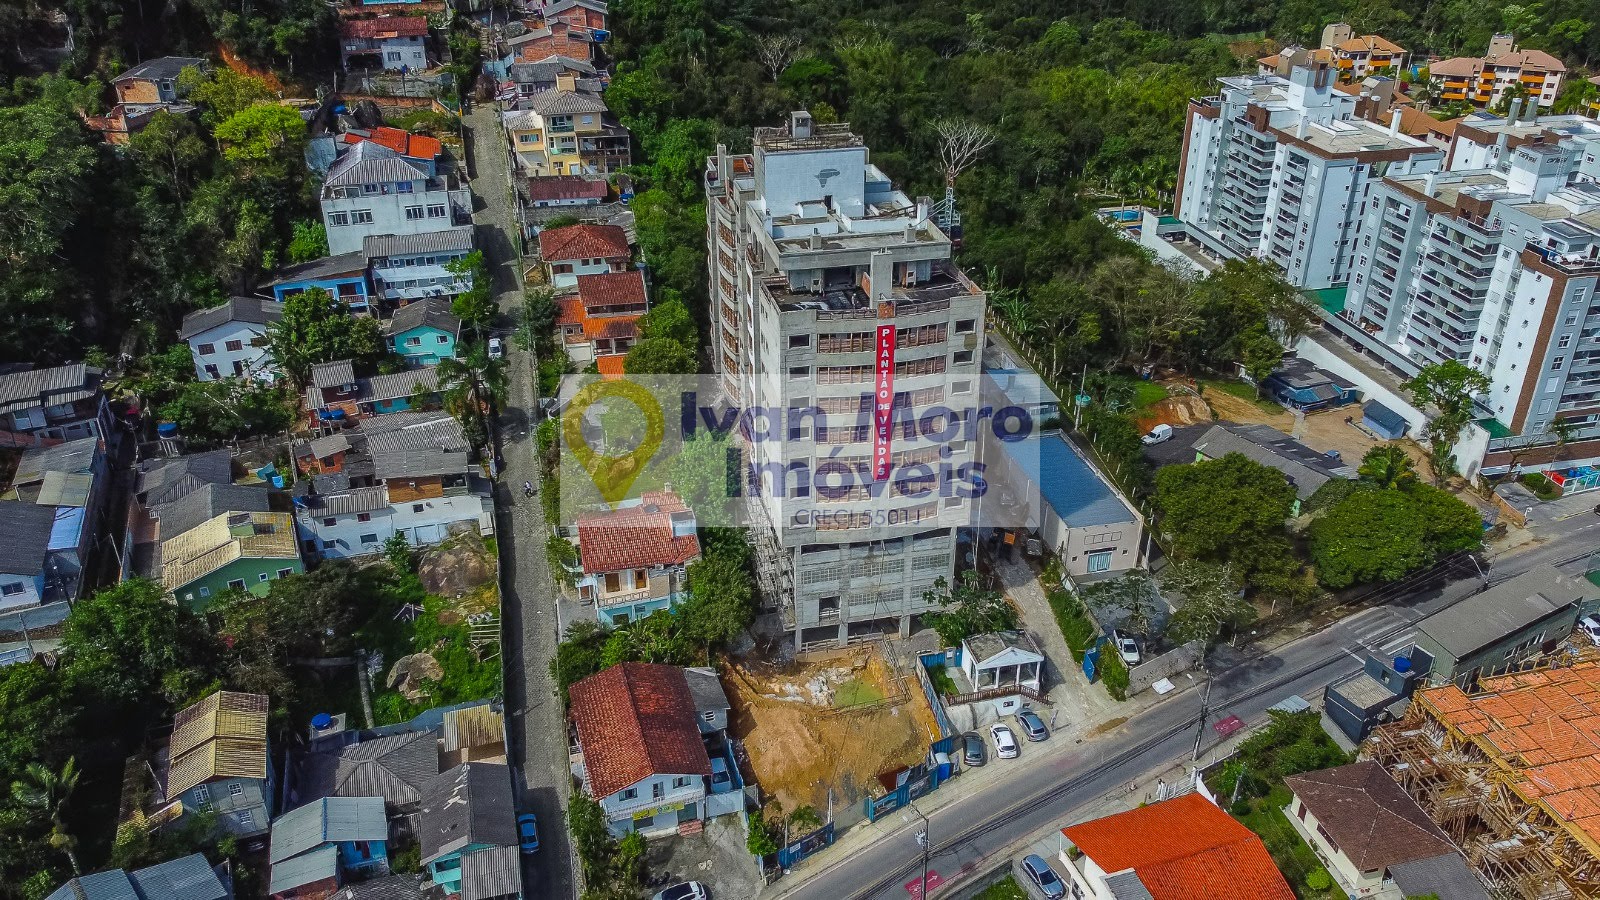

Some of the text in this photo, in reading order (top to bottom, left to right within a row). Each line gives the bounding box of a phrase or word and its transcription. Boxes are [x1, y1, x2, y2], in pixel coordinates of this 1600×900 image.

[880, 328, 890, 399] PLANTÃO
[877, 402, 890, 410] DE
[877, 416, 888, 476] VENDAS
